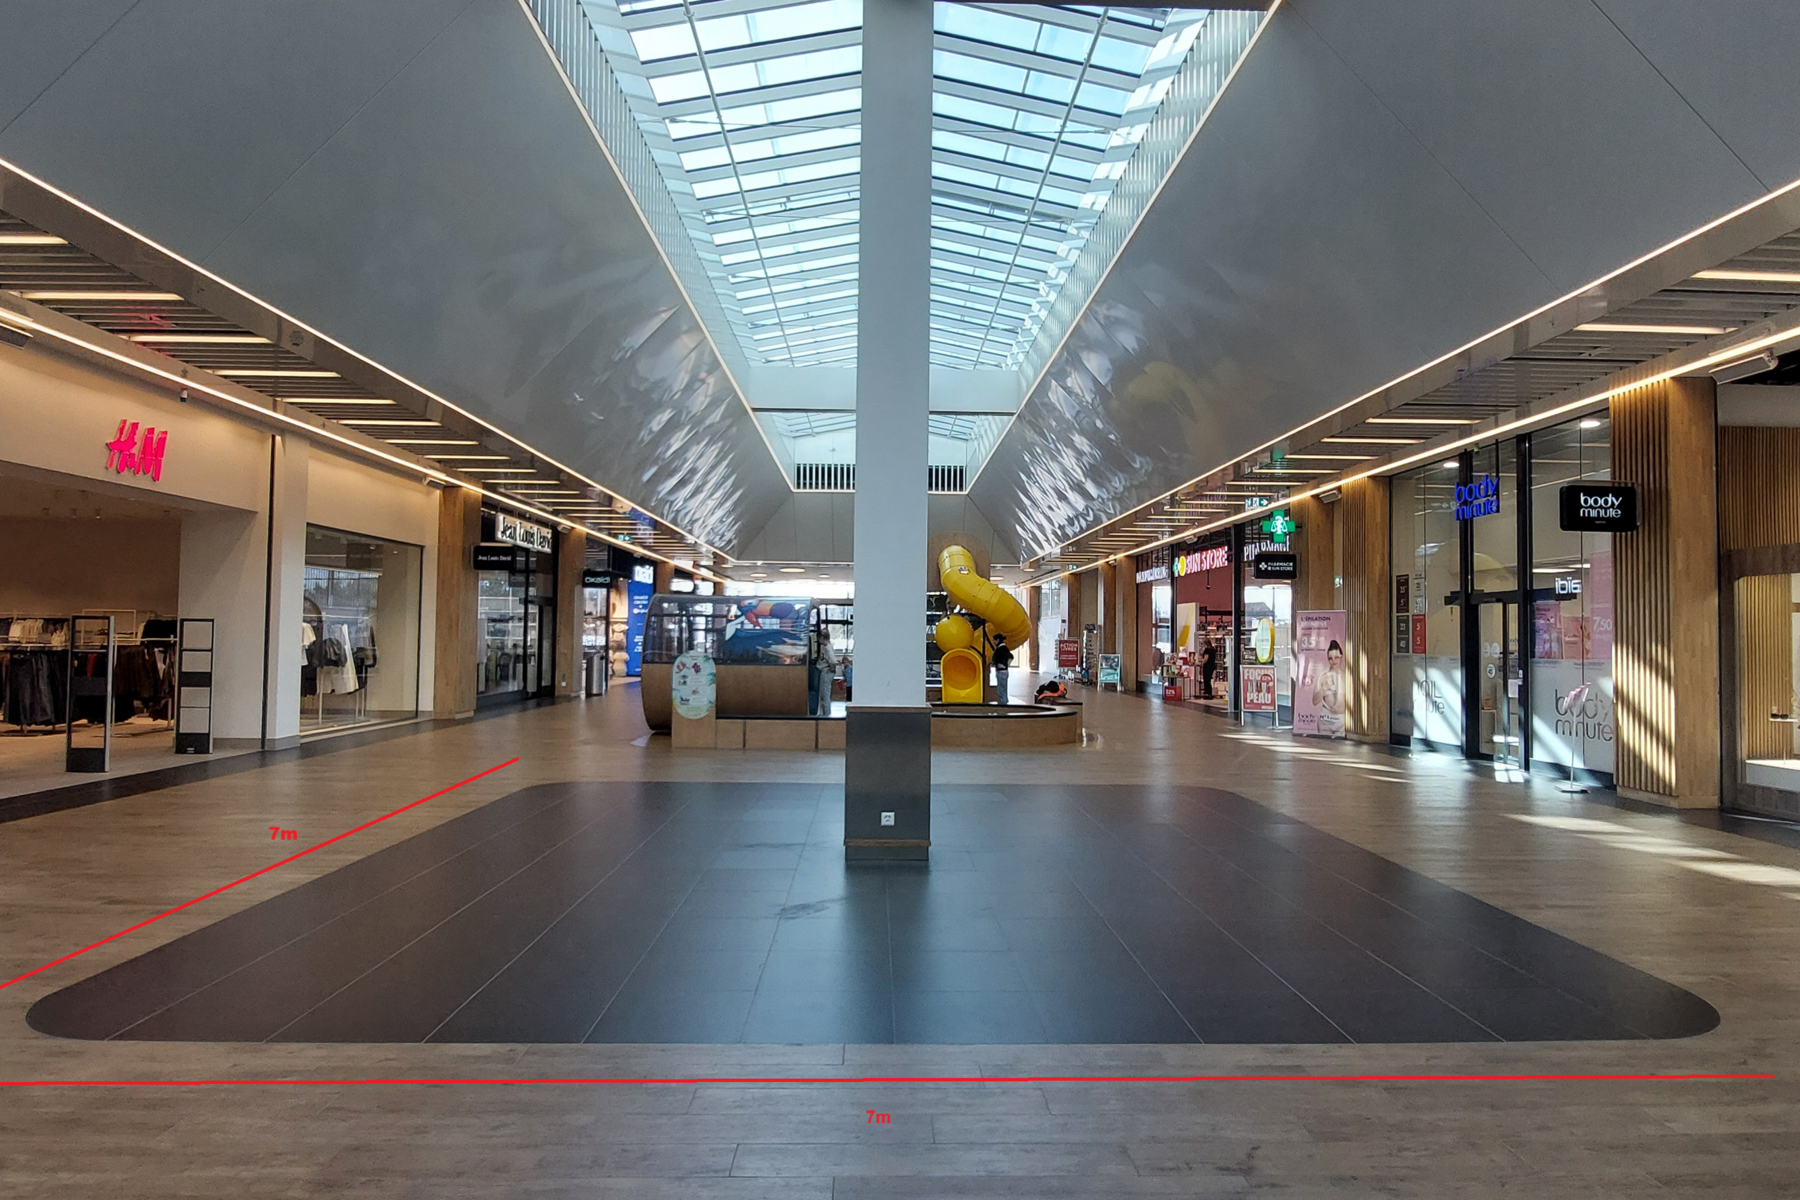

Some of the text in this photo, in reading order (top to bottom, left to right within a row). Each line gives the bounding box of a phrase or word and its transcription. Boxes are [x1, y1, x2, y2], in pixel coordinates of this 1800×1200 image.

[106, 418, 168, 482] H&M
[1455, 474, 1500, 503] body
[1580, 492, 1623, 508] body
[1455, 498, 1500, 521] minute
[1580, 507, 1622, 518] minute
[1185, 545, 1229, 575] SUN STORE
[1246, 691, 1272, 704] PEAU
[1555, 719, 1614, 742] minute
